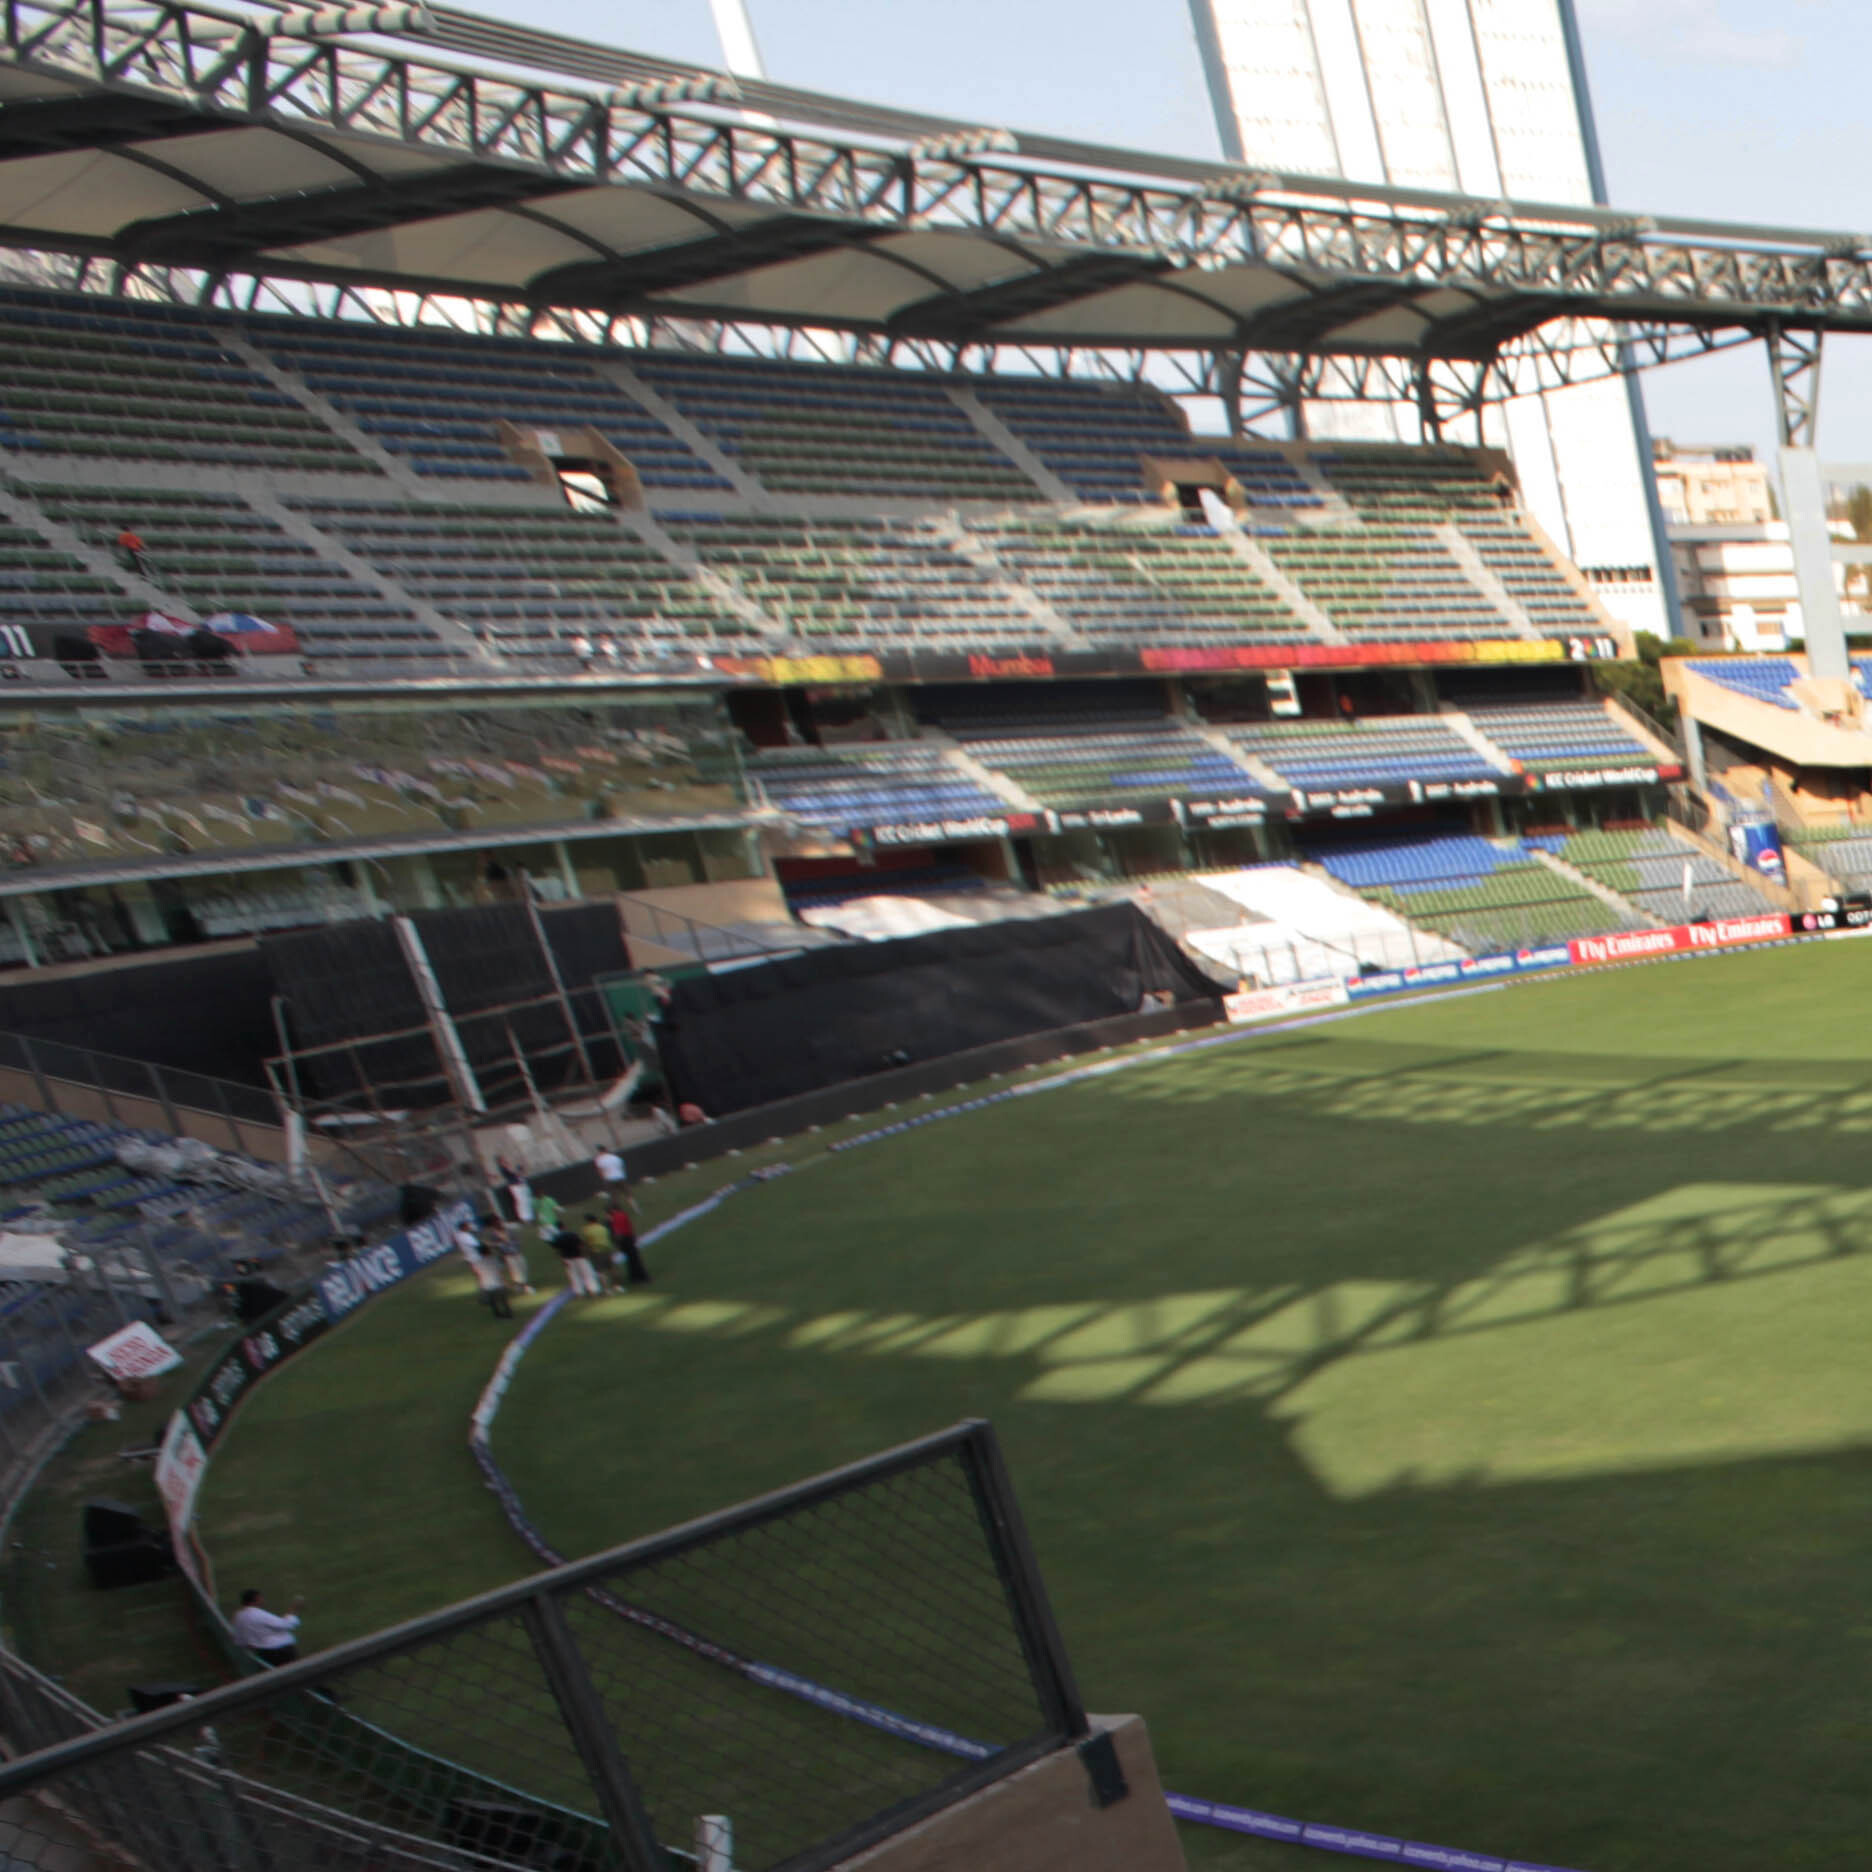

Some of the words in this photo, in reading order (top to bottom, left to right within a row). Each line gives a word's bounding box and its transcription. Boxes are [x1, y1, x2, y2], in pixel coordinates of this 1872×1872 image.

[1578, 938, 1607, 962] Fly
[1606, 930, 1675, 956] Emirates
[1689, 925, 1717, 948] Fly
[1716, 917, 1785, 942] Emirates
